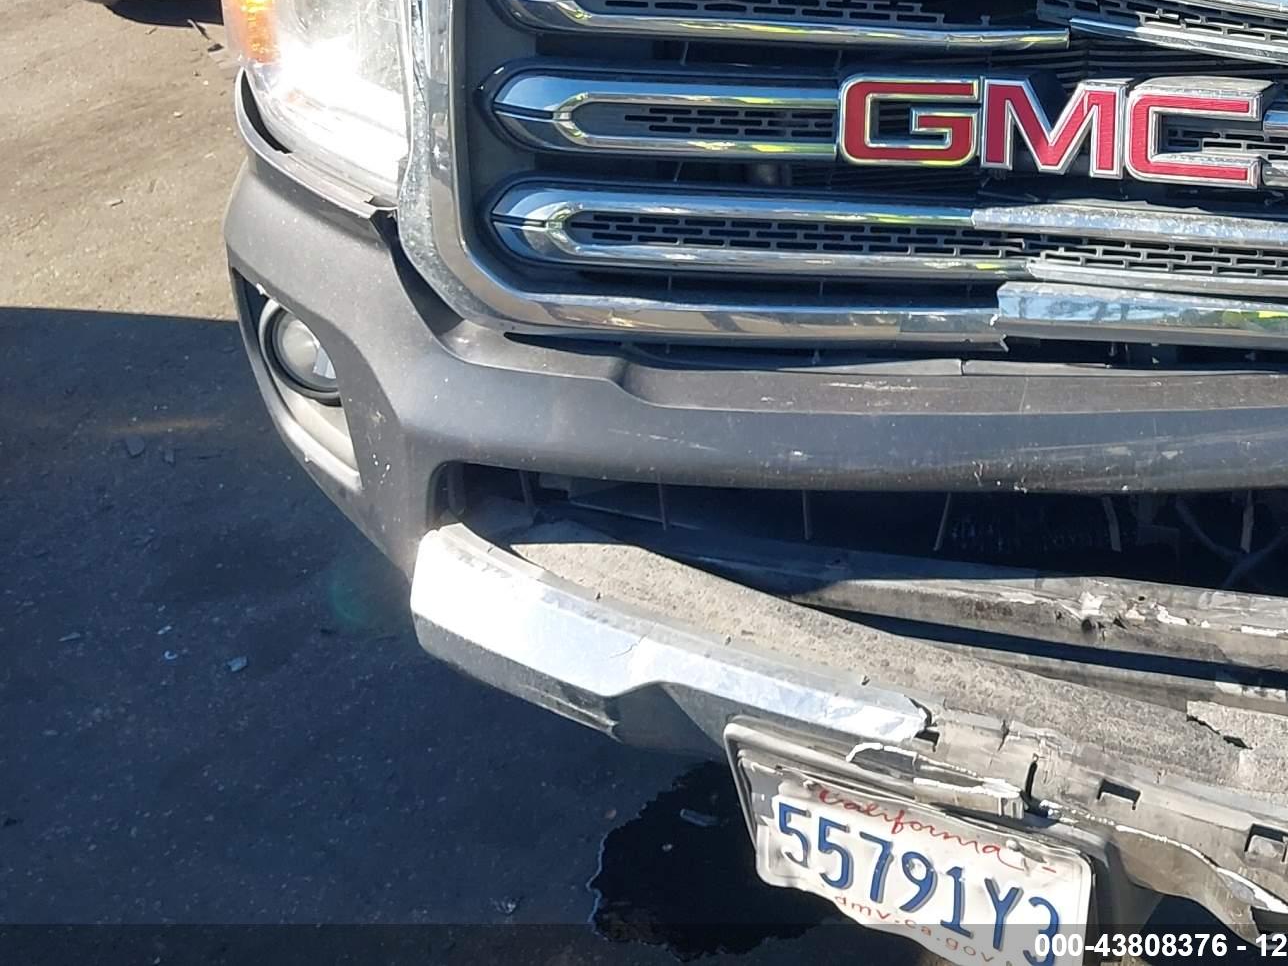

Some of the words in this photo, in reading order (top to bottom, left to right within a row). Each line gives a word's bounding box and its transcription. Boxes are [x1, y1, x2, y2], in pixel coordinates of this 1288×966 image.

[839, 74, 1267, 189] GMC
[818, 788, 1026, 872] California
[767, 801, 1061, 966] 55791Y3
[834, 895, 994, 963] dmv.ca.gov
